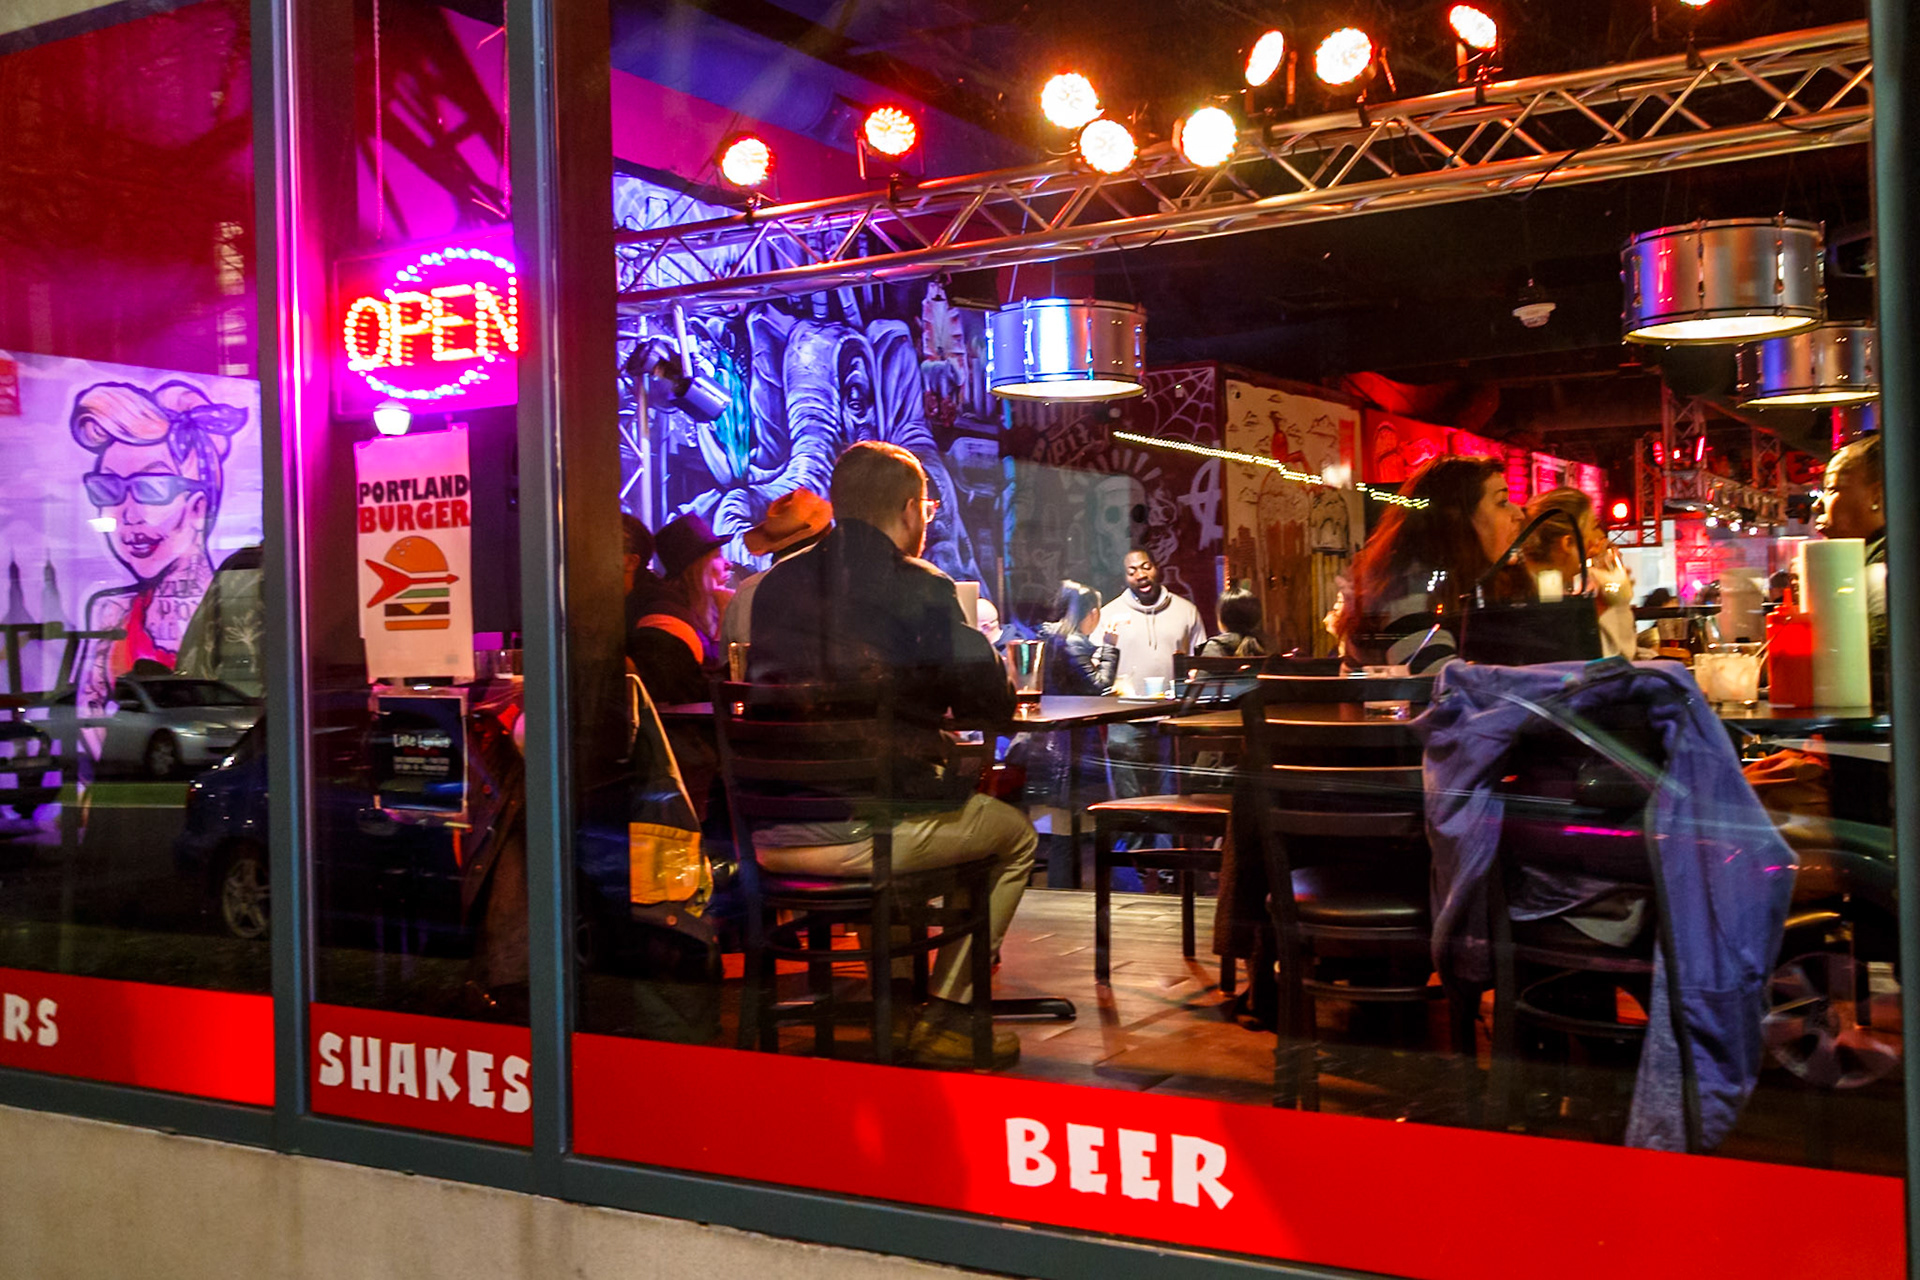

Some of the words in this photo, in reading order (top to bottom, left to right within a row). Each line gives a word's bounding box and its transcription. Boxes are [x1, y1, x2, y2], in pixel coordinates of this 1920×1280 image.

[344, 281, 519, 371] OPEN
[358, 474, 470, 504] PORTLAND
[358, 499, 470, 533] BURGER
[318, 1031, 532, 1114] SHAKES
[1005, 1116, 1234, 1210] BEER
